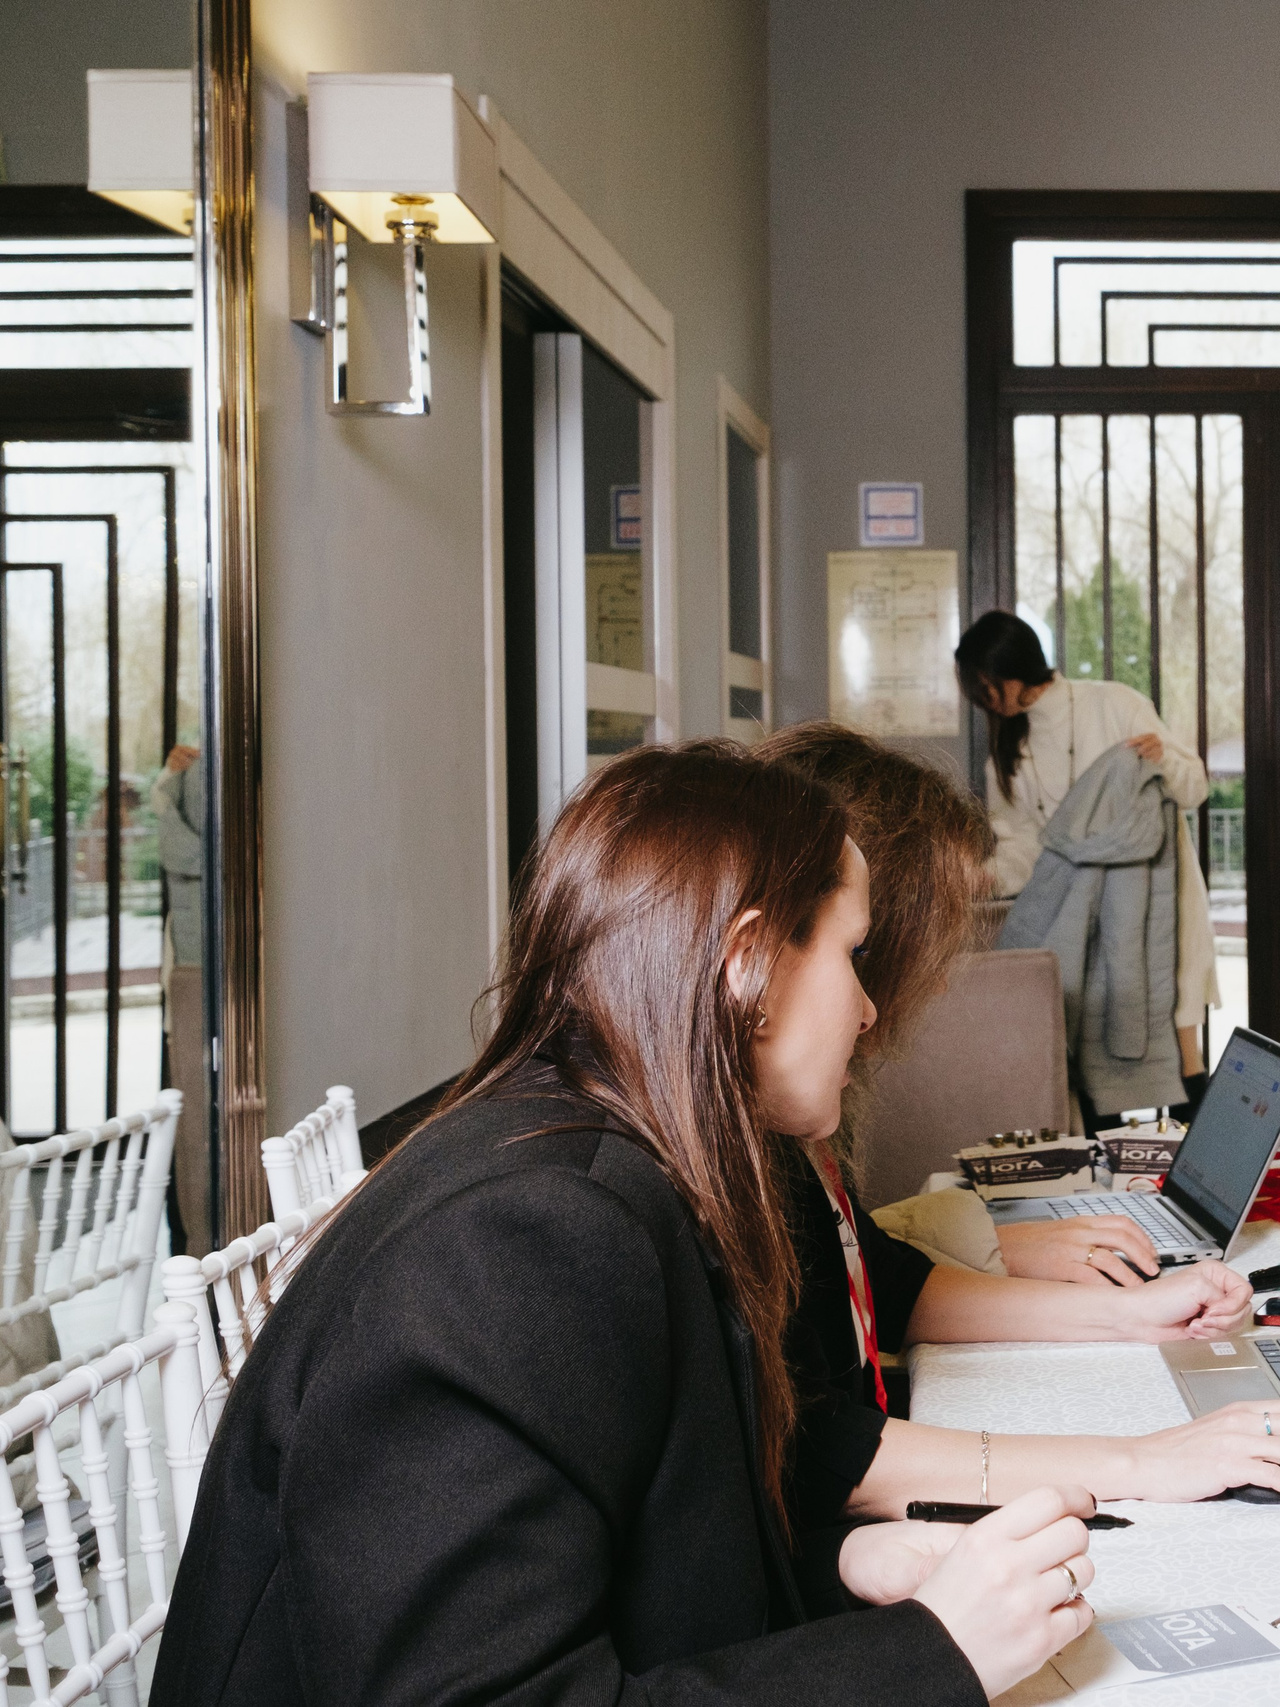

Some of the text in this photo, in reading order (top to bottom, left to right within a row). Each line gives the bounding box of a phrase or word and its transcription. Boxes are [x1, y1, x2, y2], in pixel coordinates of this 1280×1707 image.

[1120, 1149, 1174, 1161] ЮГА
[990, 1160, 1044, 1173] ЮГА
[1155, 1612, 1216, 1651] ЮГА
